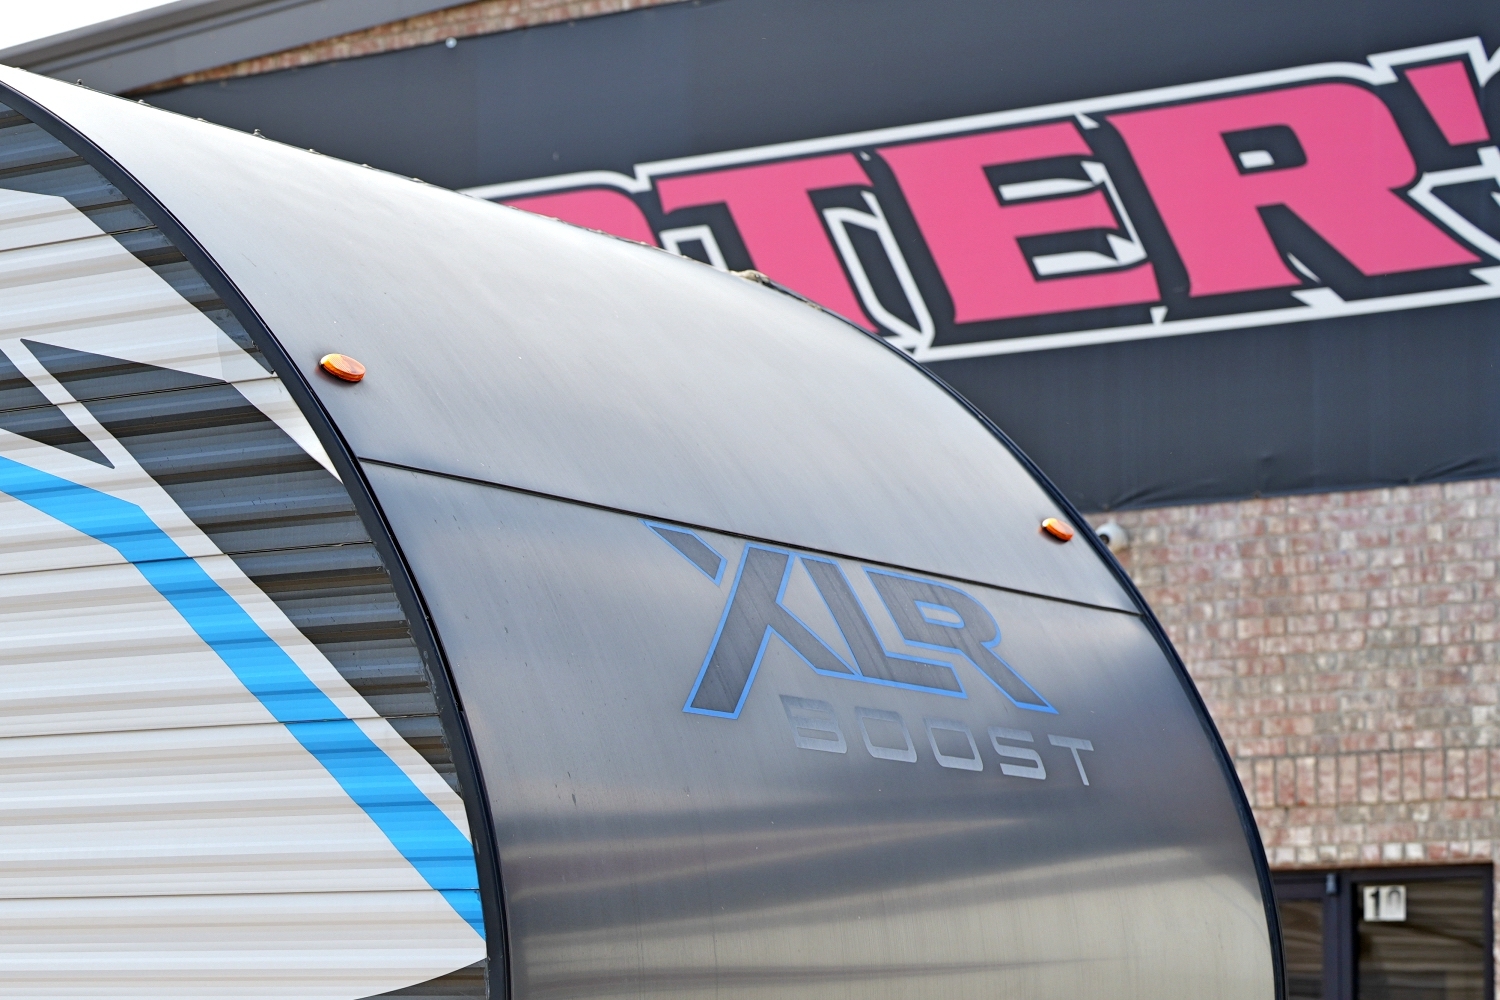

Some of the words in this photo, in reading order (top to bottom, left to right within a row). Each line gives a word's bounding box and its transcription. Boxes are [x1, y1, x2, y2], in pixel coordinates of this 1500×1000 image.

[498, 58, 1500, 334] TER'
[637, 517, 1060, 720] XLR
[779, 693, 1095, 787] BOOST
